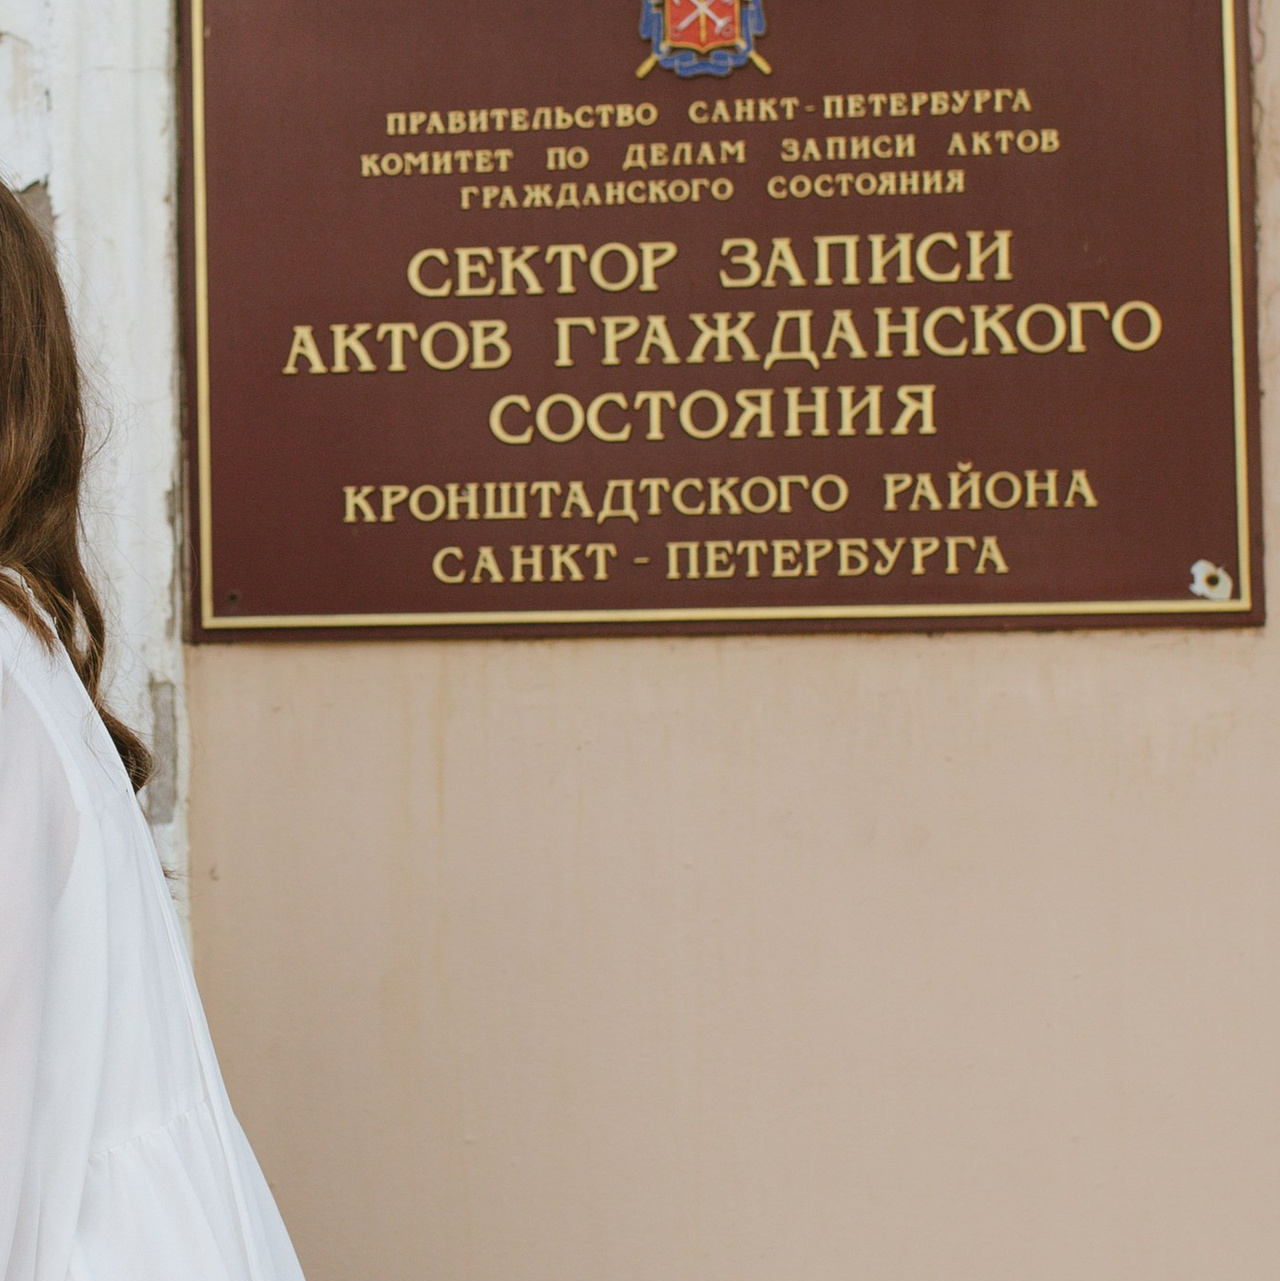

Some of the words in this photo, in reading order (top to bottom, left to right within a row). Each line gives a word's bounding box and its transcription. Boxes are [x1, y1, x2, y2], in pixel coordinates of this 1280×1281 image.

[385, 101, 660, 137] ПРАВИТЕЛЬСТВО
[687, 87, 1033, 125] САНКТ-ПЕТЕРБУРГА
[359, 147, 515, 178] КОМИТЕТ
[545, 145, 591, 172] ПО
[621, 138, 747, 172] ДЕЛАМ
[779, 132, 917, 163] ЗАПИСИ
[946, 127, 1061, 157] АКТОВ
[459, 176, 735, 211] ГРАЖДАНСКОГО
[765, 168, 966, 200] СОСТОЯНИЯ
[405, 240, 679, 299] СЕКТОР
[718, 228, 1014, 289] ЗАПИСИ
[281, 318, 513, 376] АКТОВ
[553, 299, 1164, 372] ГРАЖДАНСКОГО
[487, 383, 938, 446] СОСТОЯНИЯ
[341, 472, 850, 526] КРОНШТАДТСКОГО
[882, 460, 1099, 512] РАЙОНА
